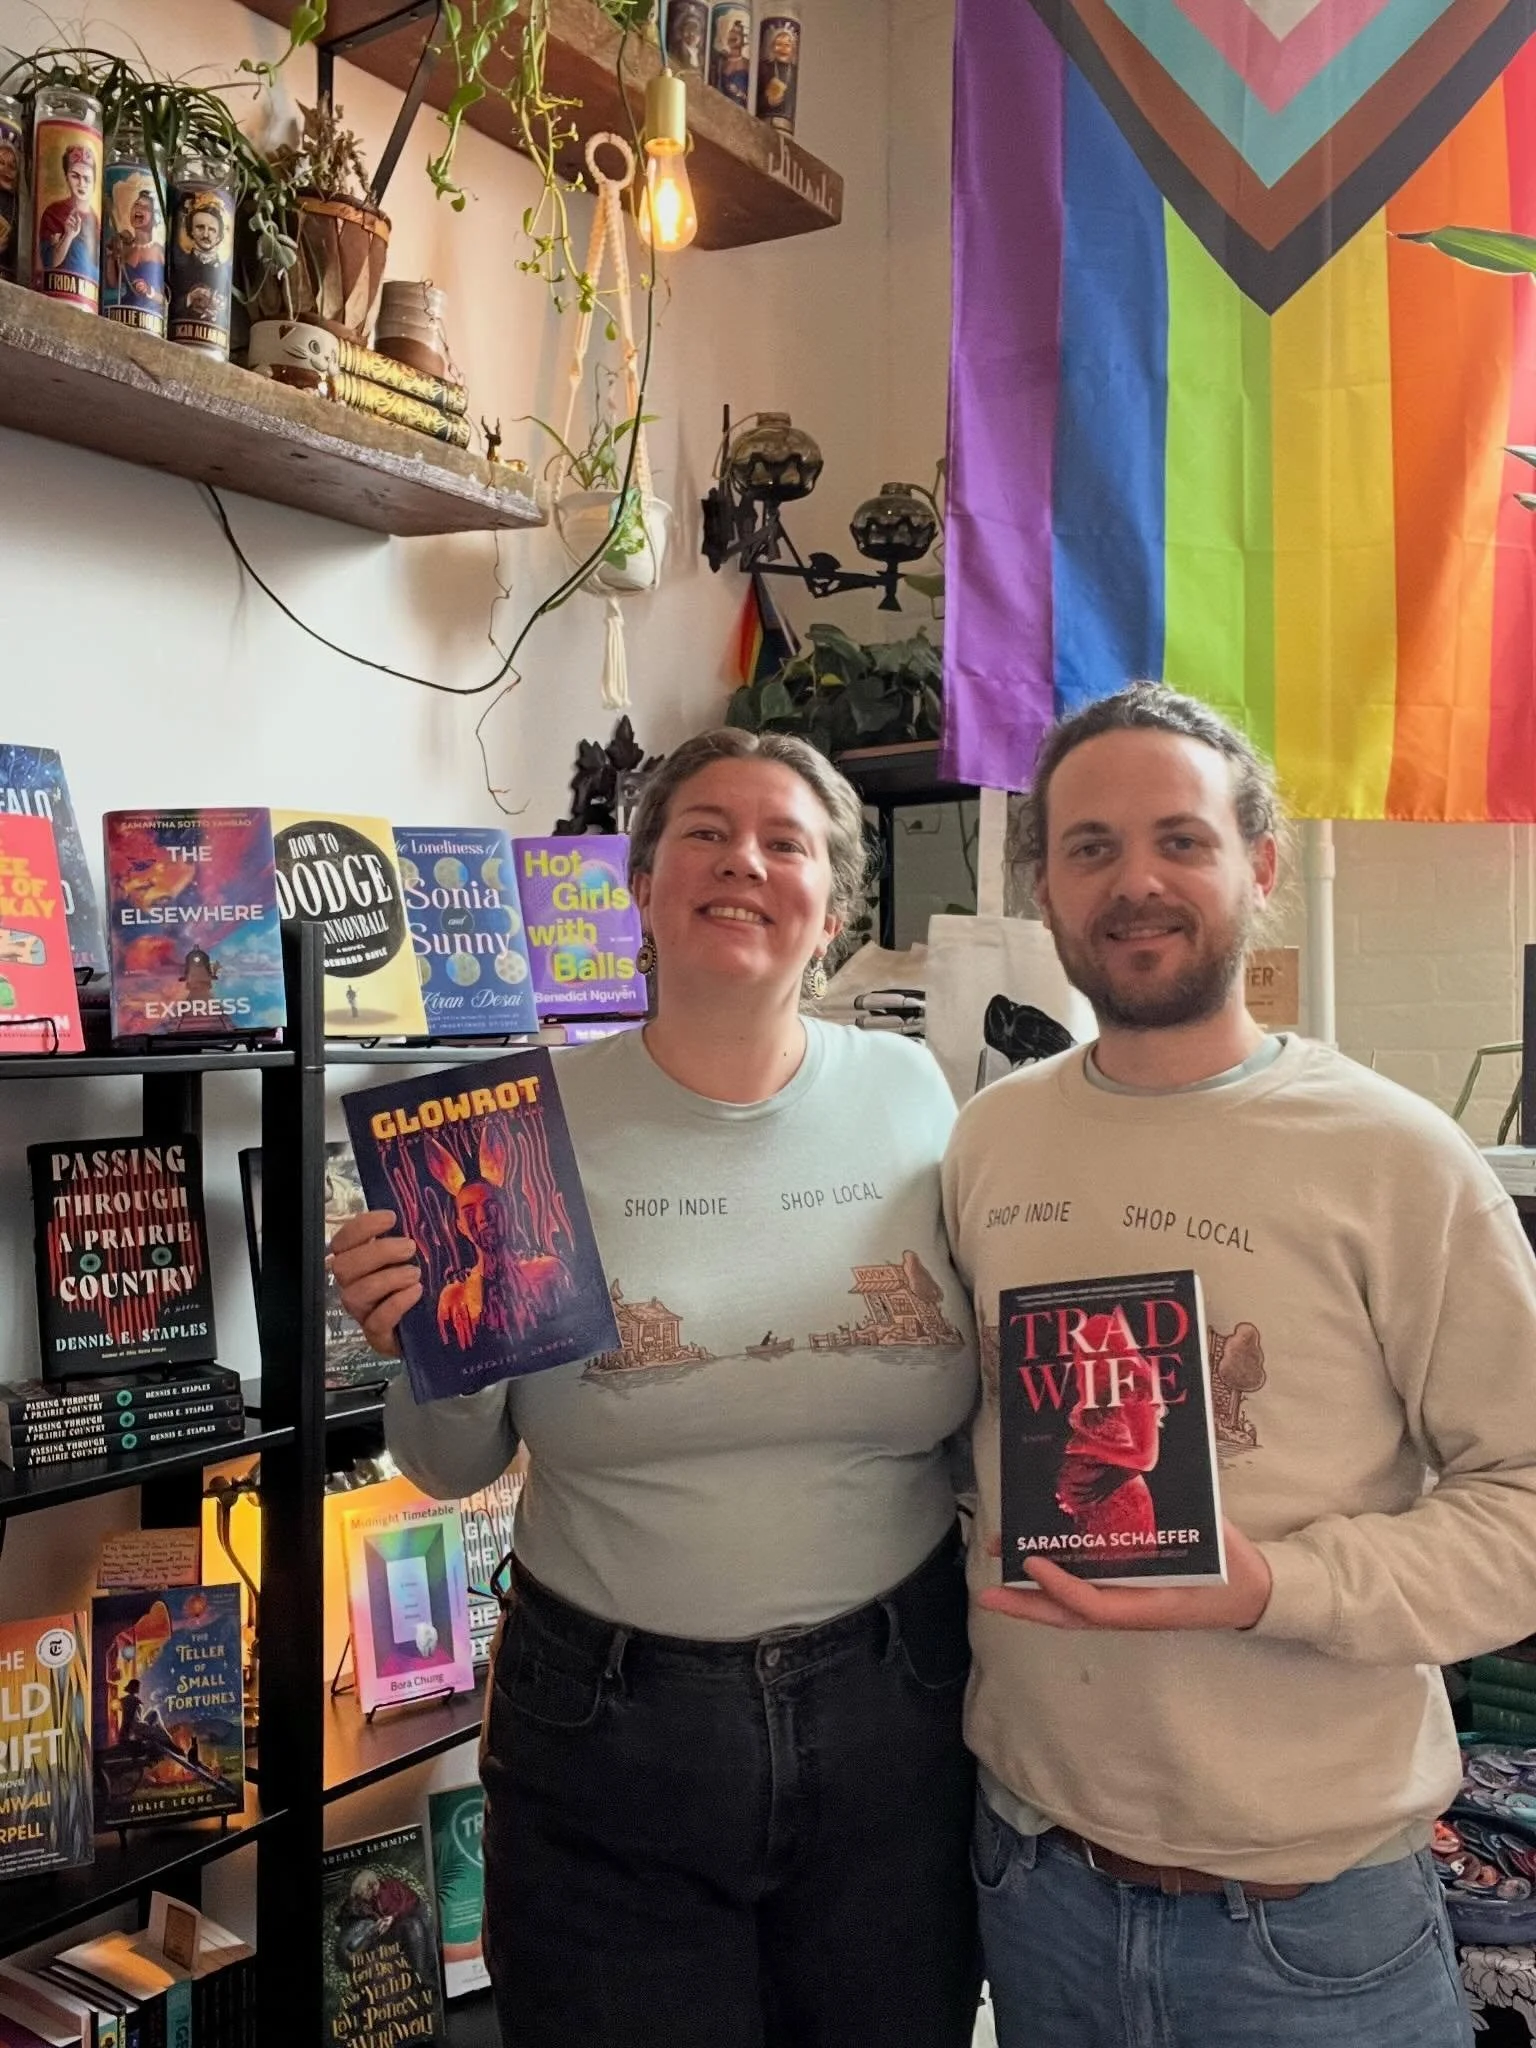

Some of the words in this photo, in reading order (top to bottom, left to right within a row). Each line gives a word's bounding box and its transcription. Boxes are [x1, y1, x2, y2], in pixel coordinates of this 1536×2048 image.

[49, 274, 76, 293] FRIDA
[120, 820, 177, 831] SAMANTHA
[178, 819, 210, 830] SOTTO
[166, 845, 212, 863] THE
[288, 834, 317, 859] HOW
[318, 832, 340, 854] TO
[411, 839, 485, 855] Loneliness
[524, 850, 582, 878] Hot
[275, 853, 393, 920] DODGE
[403, 878, 500, 910] Sonia
[552, 881, 631, 911] Girls
[121, 904, 264, 925] ELSEWHERE
[409, 922, 511, 960] Sunny
[527, 917, 598, 947] with
[553, 951, 636, 983] Balls
[422, 990, 465, 1015] Kiran
[471, 988, 524, 1009] Desai
[535, 989, 587, 1004] Benedict
[145, 996, 251, 1019] EXPRESS
[371, 1075, 539, 1140] GLOWROT
[51, 1145, 187, 1181] PASSING
[53, 1187, 188, 1218] THROUGH
[781, 1190, 824, 1212] SHOP
[832, 1181, 883, 1206] LOCAL
[624, 1198, 670, 1218] SHOP
[679, 1197, 729, 1217] INDIE
[987, 1203, 1020, 1228] SHOP
[1025, 1201, 1071, 1224] INDIE
[59, 1231, 73, 1254] A
[84, 1221, 193, 1251] PRAIRIE
[1123, 1204, 1177, 1232] SHOP
[1186, 1216, 1254, 1254] LOCAL
[59, 1265, 195, 1302] COUNTRY
[856, 1268, 895, 1281] BOOKS
[55, 1332, 114, 1352] DENNIS
[121, 1331, 136, 1346] E.
[142, 1321, 208, 1343] STAPLES
[1010, 1300, 1189, 1360] TRAD
[146, 1388, 171, 1399] DENNIS
[181, 1383, 211, 1394] STAPLES
[1016, 1352, 1187, 1414] WIFE
[26, 1398, 60, 1411] PASSING
[62, 1393, 100, 1406] THROUGH
[31, 1407, 64, 1419] PRAIRIE
[67, 1401, 103, 1414] COUNTRY
[148, 1409, 174, 1420] DENNIS
[185, 1404, 214, 1415] STAPLES
[28, 1421, 61, 1434] PASSING
[64, 1415, 102, 1428] THROUGH
[33, 1429, 67, 1441] PRAIRIE
[69, 1423, 105, 1436] COUNTRY
[150, 1431, 176, 1441] DENNIS
[186, 1424, 216, 1436] STAPLES
[31, 1443, 64, 1457] PASSING
[66, 1437, 105, 1451] THROUGH
[36, 1451, 69, 1464] PRAIRIE
[71, 1445, 108, 1459] COUNTRY
[351, 1512, 400, 1530] Midnight
[402, 1504, 454, 1521] Timetable
[1017, 1533, 1106, 1550] SARATOGA
[1110, 1528, 1200, 1547] SCHAEFER
[192, 1632, 208, 1642] THE
[176, 1645, 225, 1663] TELLER
[194, 1663, 206, 1673] OF
[177, 1674, 225, 1694] SMALL
[391, 1680, 412, 1692] Bora
[414, 1674, 444, 1687] Chung
[165, 1692, 236, 1712] FORTUNES
[130, 1801, 164, 1813] JULIE
[173, 1794, 213, 1807] LEONG
[367, 1832, 417, 1854] LEMMING
